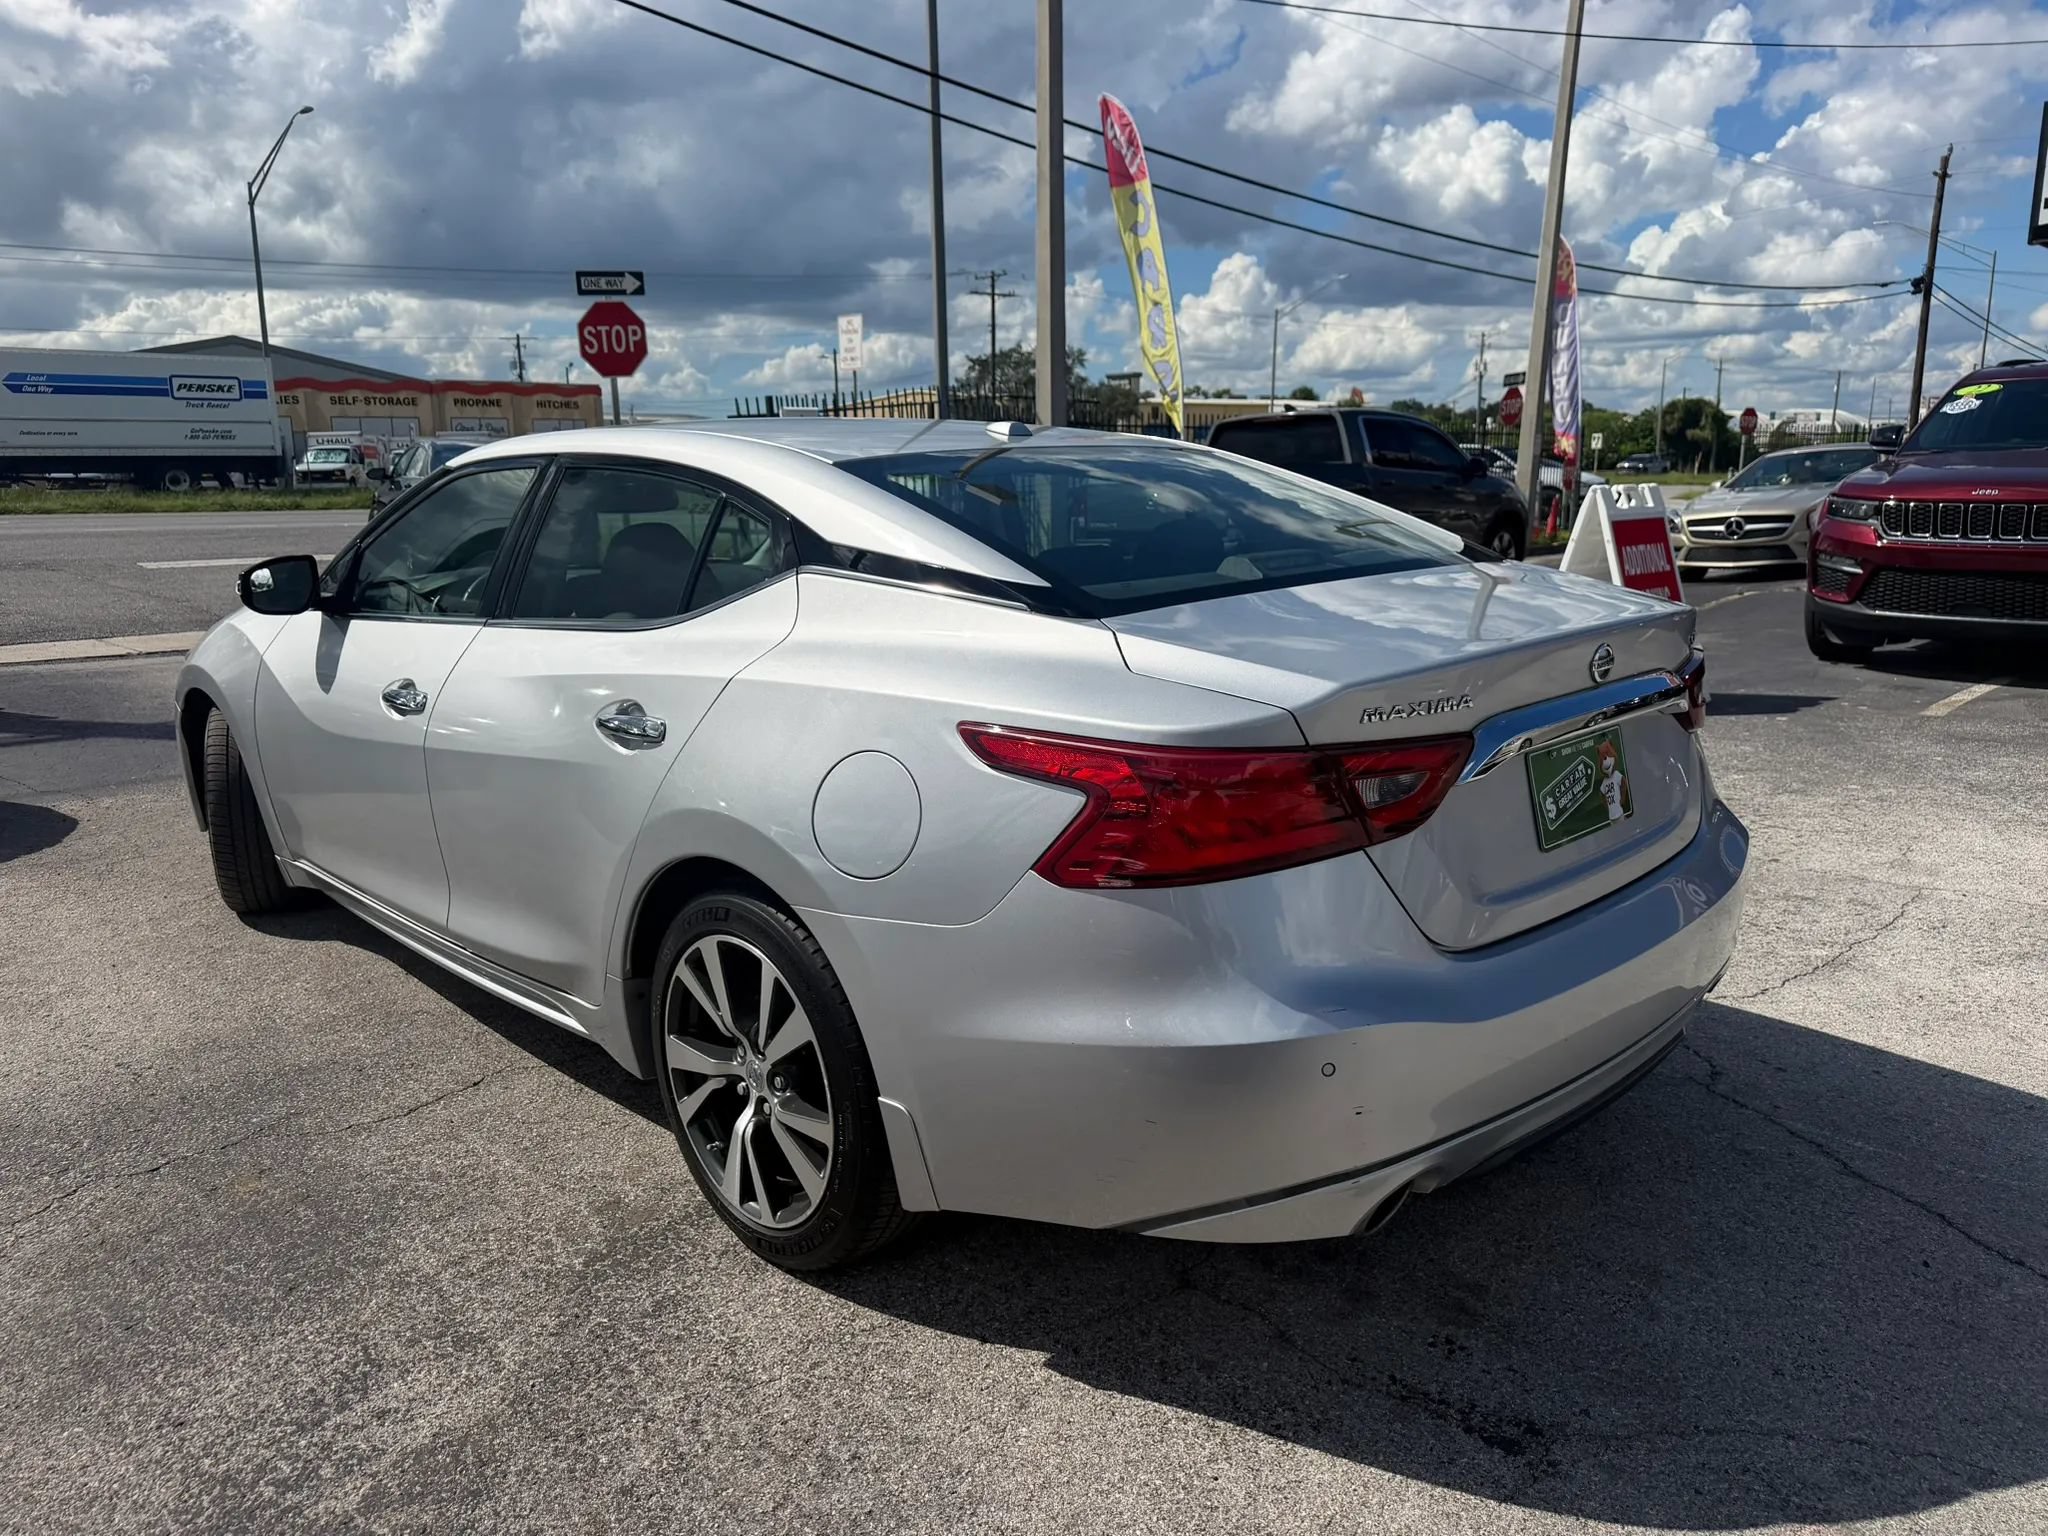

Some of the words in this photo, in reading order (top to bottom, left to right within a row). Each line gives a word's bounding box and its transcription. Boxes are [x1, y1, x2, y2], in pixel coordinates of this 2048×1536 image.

[583, 277, 602, 289] ONE
[605, 278, 624, 289] WAY
[583, 324, 642, 355] STOP
[26, 373, 48, 382] Local
[37, 385, 54, 394] Way
[176, 383, 237, 394] PENSKE
[329, 394, 419, 408] SELF-STORAGE
[453, 398, 503, 409] PROPANE
[535, 399, 580, 411] HITCHES
[1500, 398, 1522, 417] STOP
[316, 437, 353, 445] U-HAUL
[1971, 487, 1999, 496] Jeep
[1621, 542, 1671, 577] ADDITIONAL
[1359, 693, 1474, 724] MAXIMA
[1555, 762, 1586, 797] CARFAX
[1558, 788, 1573, 809] GREAT
[1573, 776, 1588, 795] VALUE
